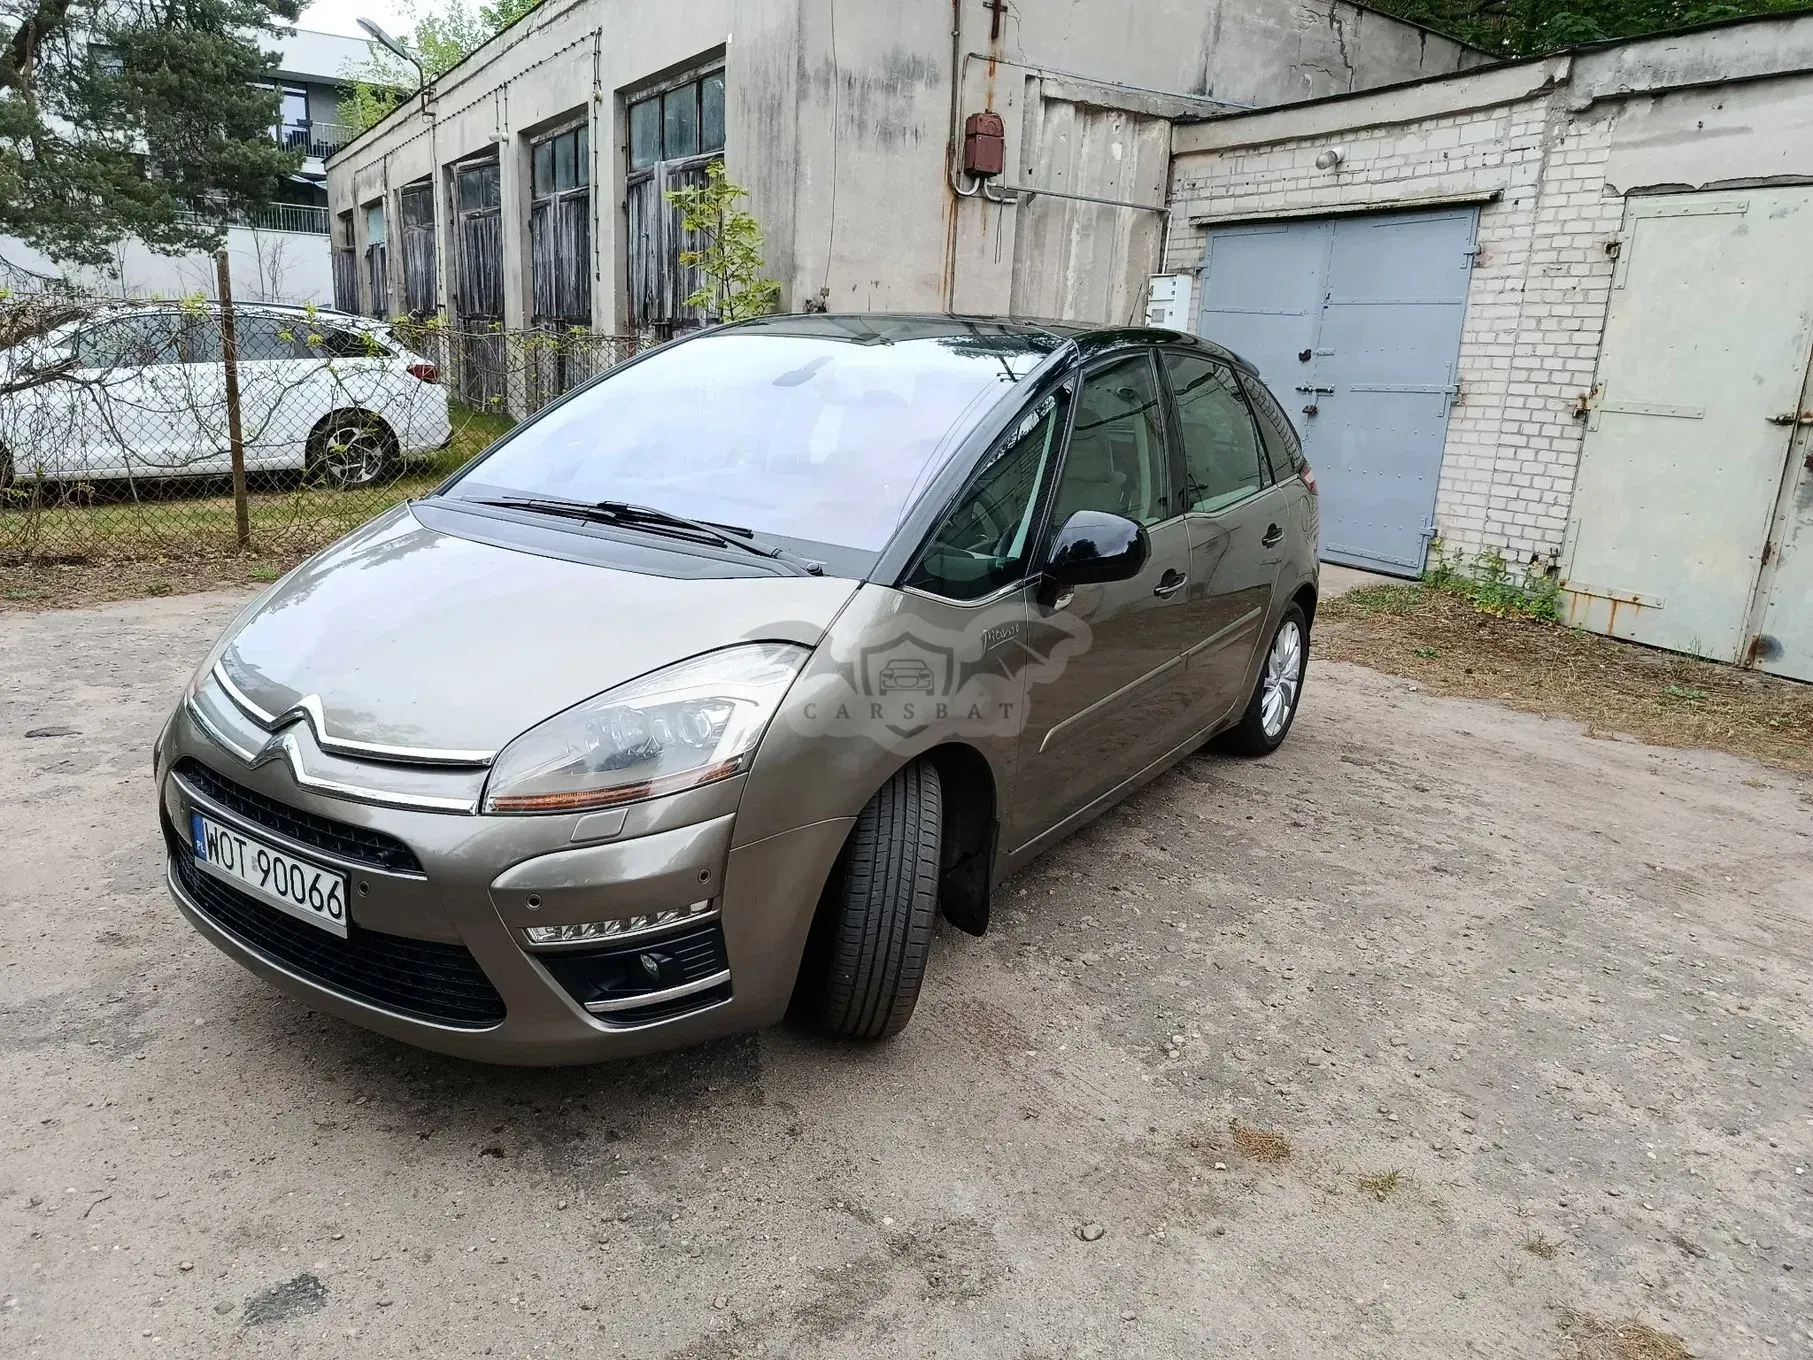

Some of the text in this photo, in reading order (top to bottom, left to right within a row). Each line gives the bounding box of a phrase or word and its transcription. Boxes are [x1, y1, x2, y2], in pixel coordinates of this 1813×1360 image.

[196, 841, 206, 854] PL
[204, 821, 343, 920] WOT 90066
